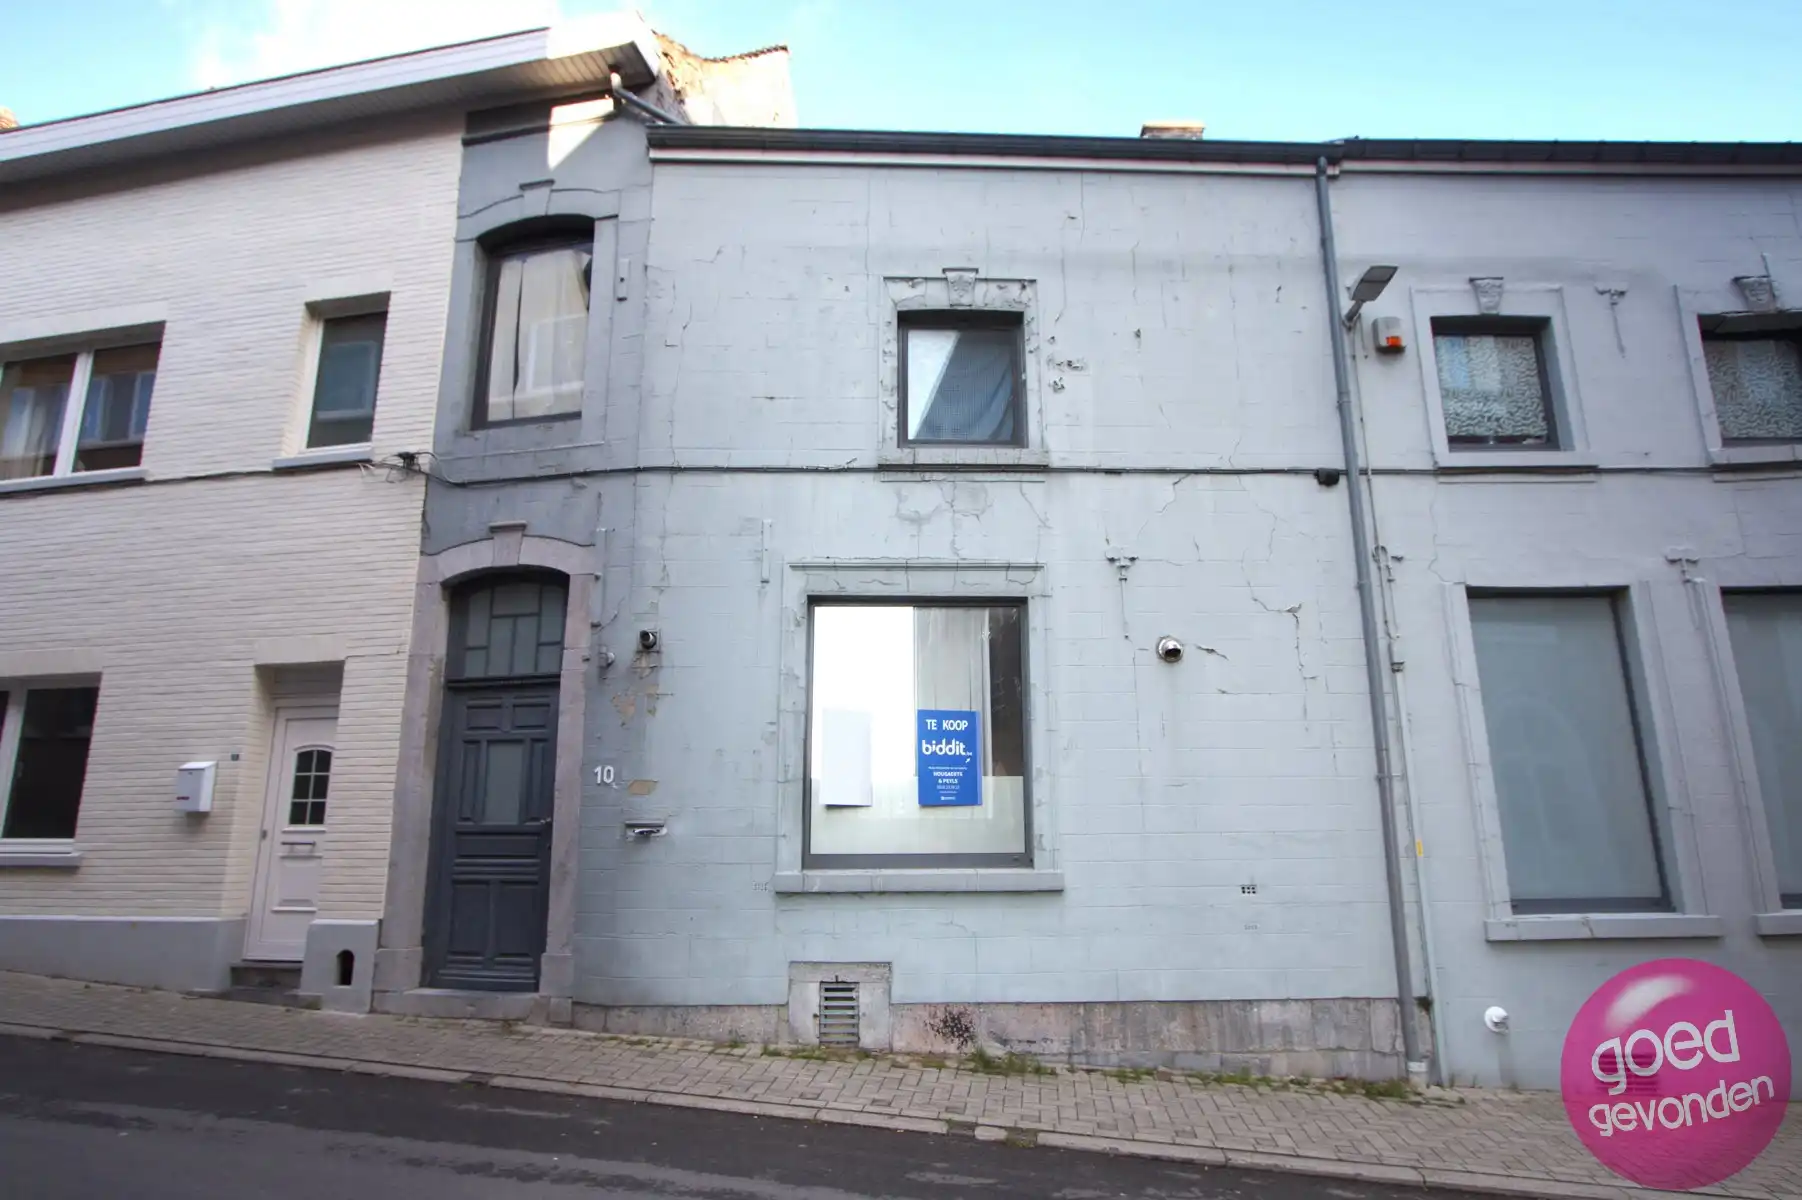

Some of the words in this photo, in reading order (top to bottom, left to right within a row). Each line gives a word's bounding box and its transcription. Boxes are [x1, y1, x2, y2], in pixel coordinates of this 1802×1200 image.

[925, 719, 937, 730] TE
[942, 719, 968, 731] KOOP
[594, 765, 614, 784] 10
